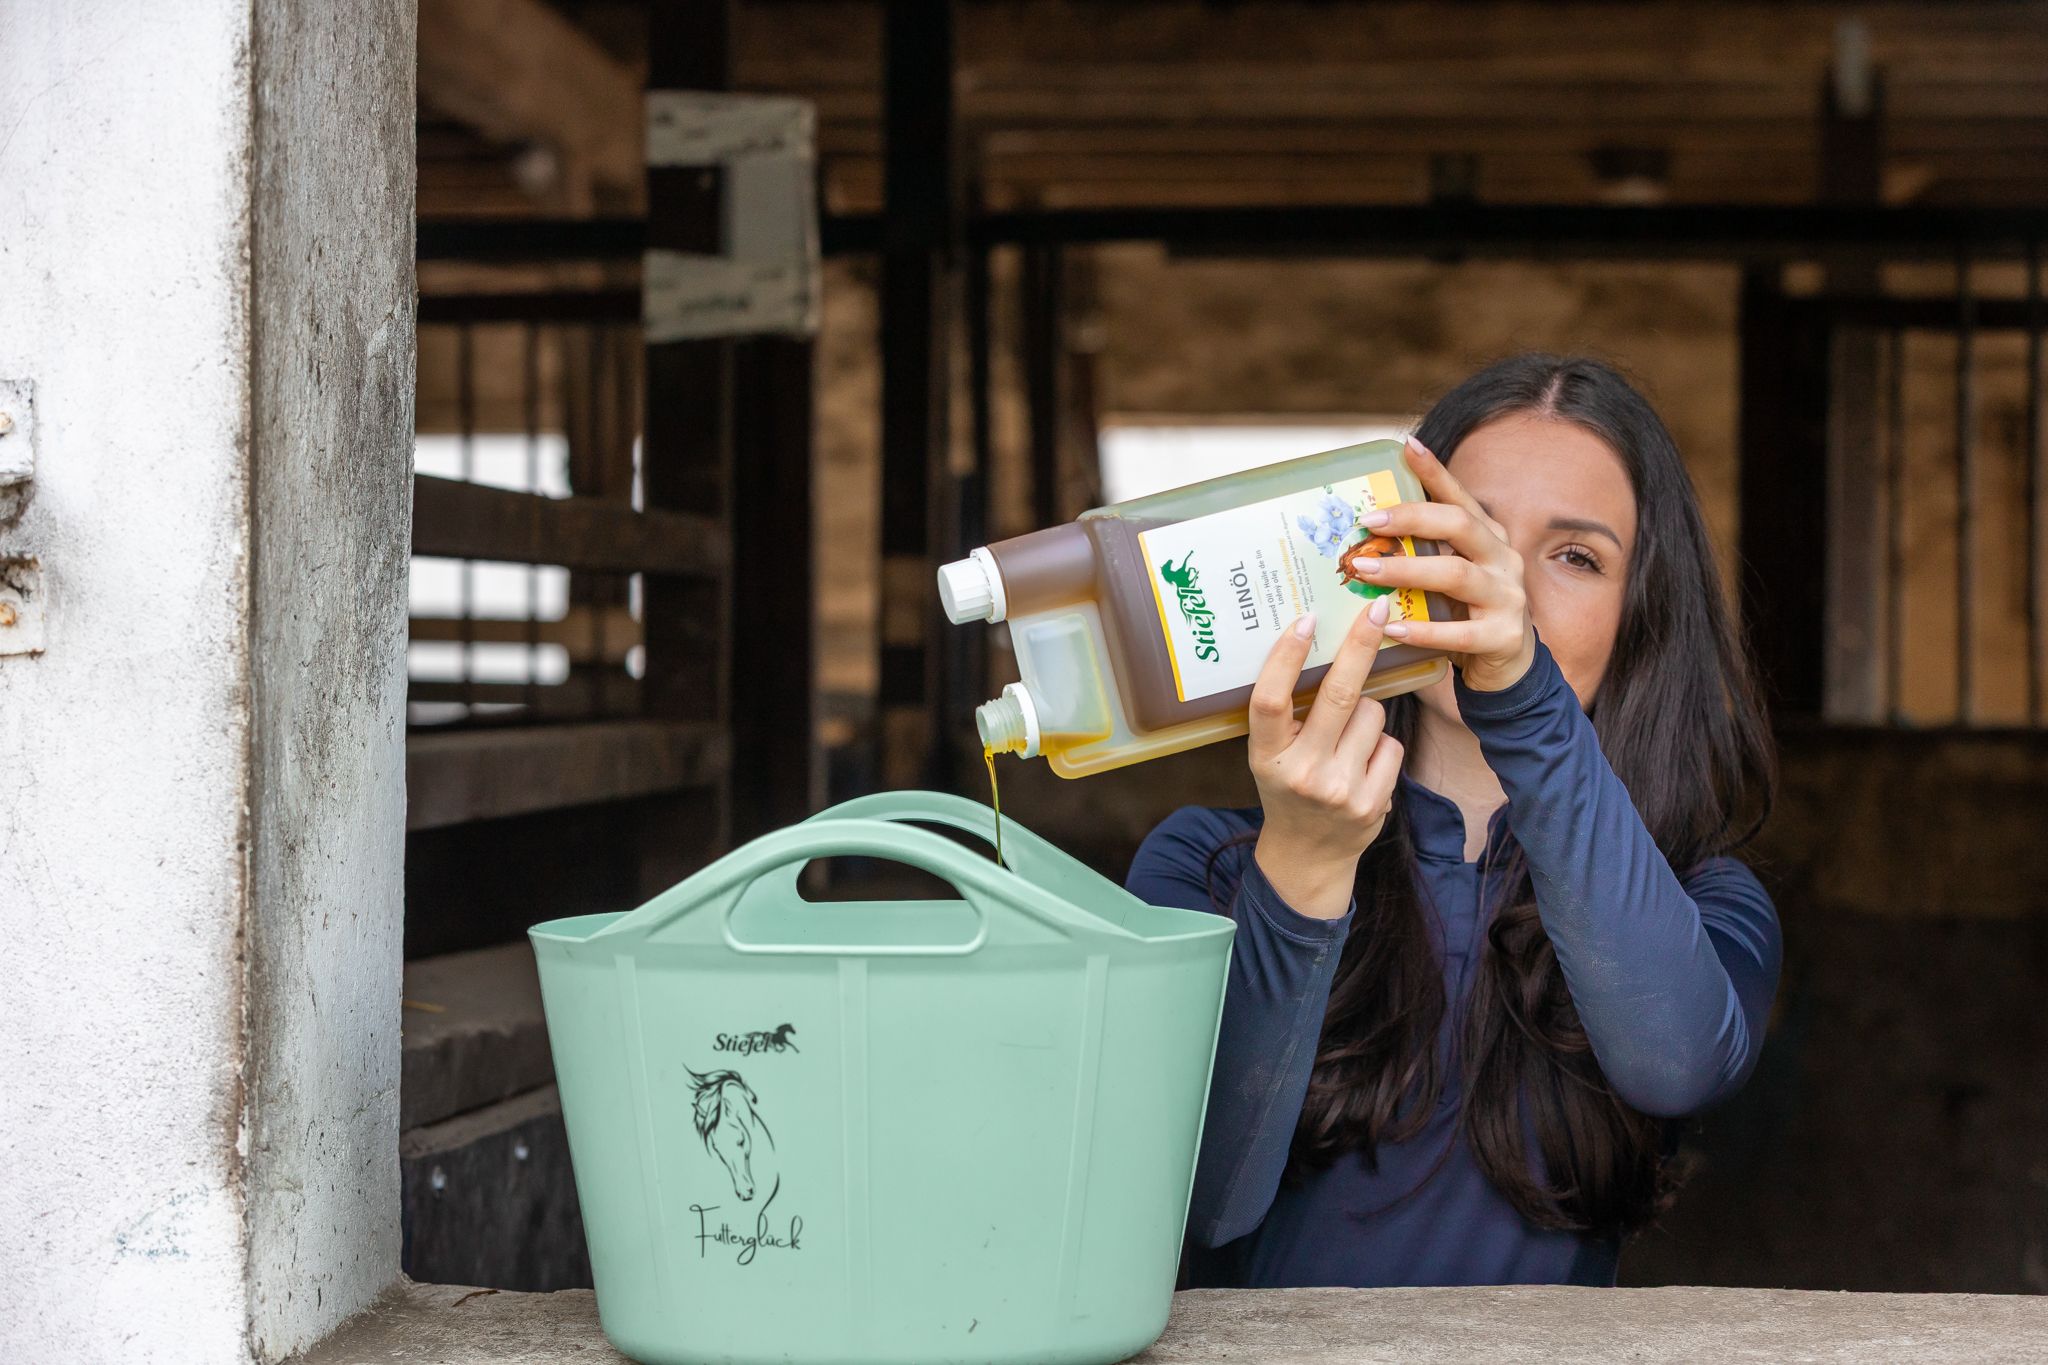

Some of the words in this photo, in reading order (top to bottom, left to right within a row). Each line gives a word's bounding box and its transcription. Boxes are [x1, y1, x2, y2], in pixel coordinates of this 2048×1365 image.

[1258, 560, 1264, 569] de
[1270, 569, 1279, 583] olej
[1261, 570, 1270, 588] Huile
[1229, 561, 1260, 631] LEINÖL
[1180, 588, 1220, 662] Stiefel
[1269, 604, 1280, 630] Linseed
[713, 1033, 770, 1056] Stiefel
